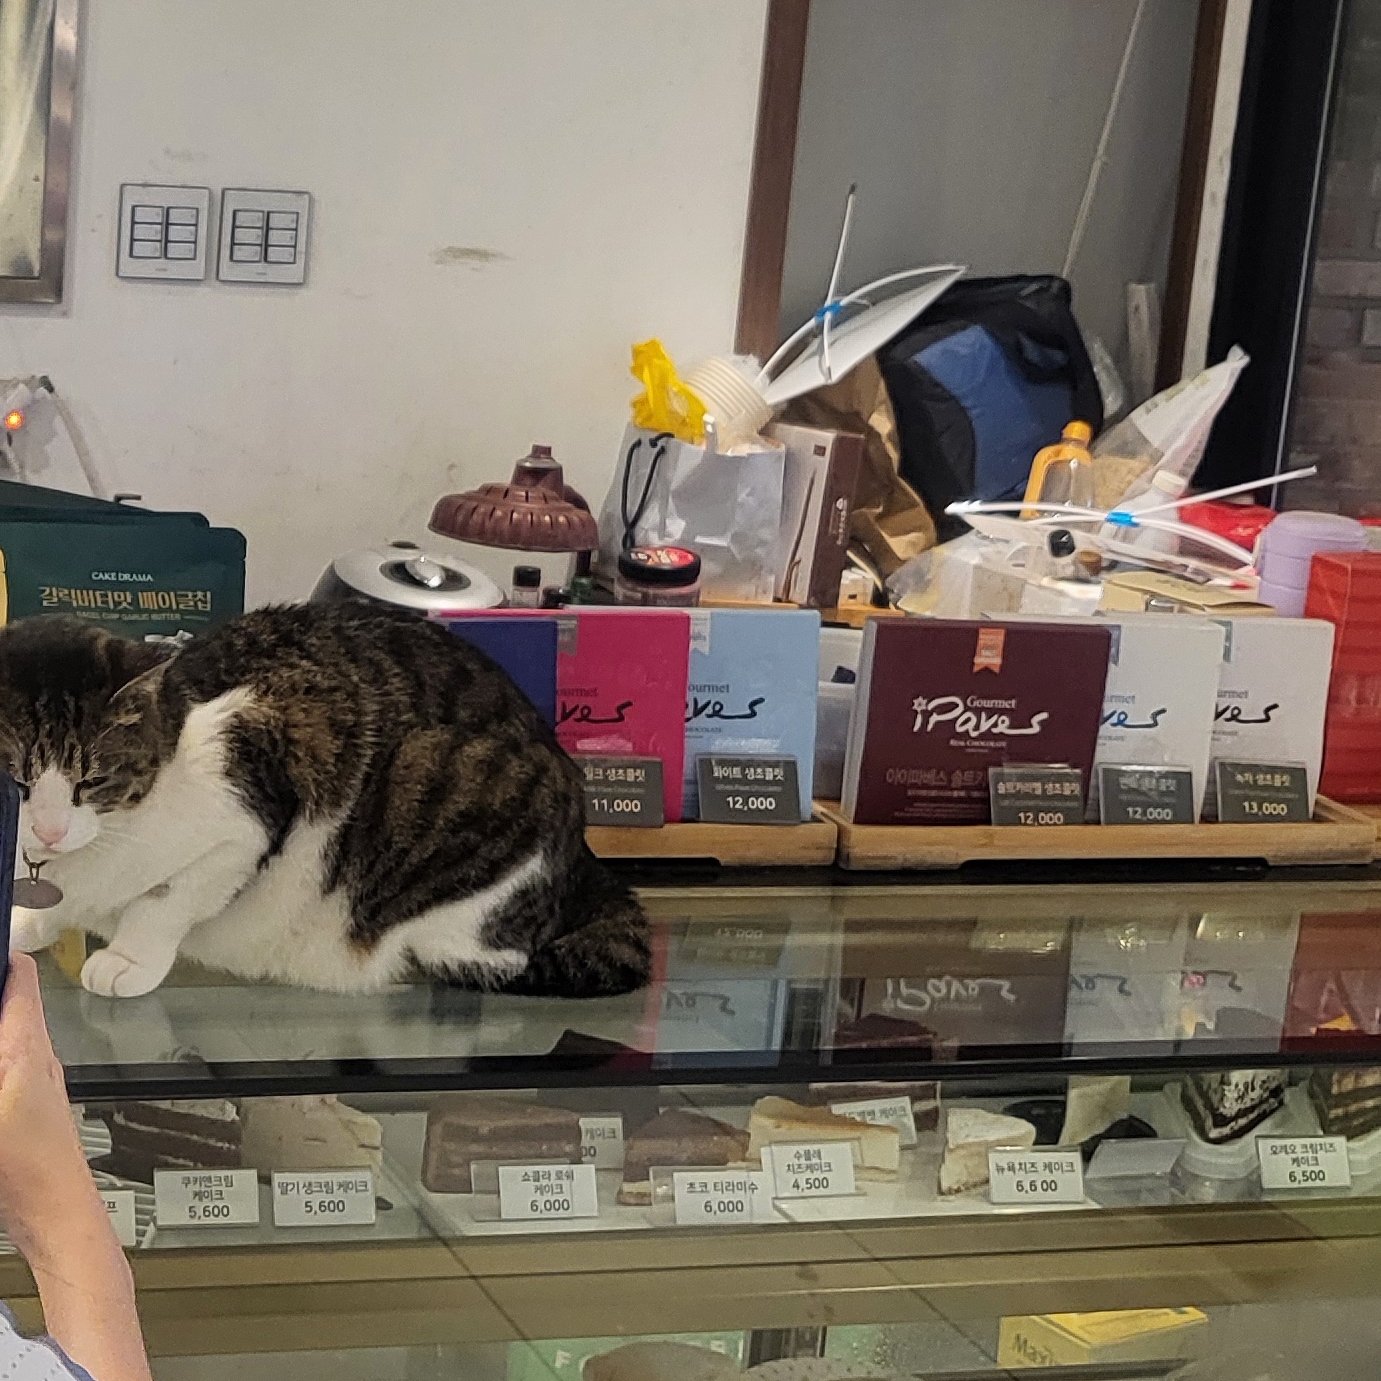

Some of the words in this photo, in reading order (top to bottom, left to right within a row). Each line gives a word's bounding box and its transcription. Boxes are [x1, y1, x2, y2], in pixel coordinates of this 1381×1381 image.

[91, 572, 117, 581] CAKE
[966, 695, 1018, 709] Gourmet
[591, 798, 641, 813] 11,000
[725, 796, 776, 811] 12,000
[1242, 801, 1288, 816] 13,000
[1018, 811, 1064, 826] 12,000
[1126, 806, 1172, 821] 12,000
[1300, 1141, 1337, 1155] 크림치즈
[786, 1161, 834, 1174] 치즈케이크
[994, 1161, 1040, 1175] 뉴욕치즈
[1042, 1161, 1076, 1174] 케이크
[1290, 1155, 1320, 1168] 케이크
[792, 1176, 830, 1192] 4,500
[1288, 1169, 1326, 1185] 6,500
[277, 1181, 299, 1195] 딸기
[302, 1180, 334, 1195] 생크림
[336, 1179, 369, 1194] 케이크
[534, 1183, 564, 1197] 케이크
[686, 1180, 710, 1194] 초코
[713, 1180, 759, 1194] 티라미수
[192, 1189, 225, 1202] 케이크
[188, 1204, 230, 1220] 5,600
[304, 1199, 346, 1216] 5,600
[530, 1198, 571, 1215] 6,000
[703, 1199, 745, 1216] 6,000
